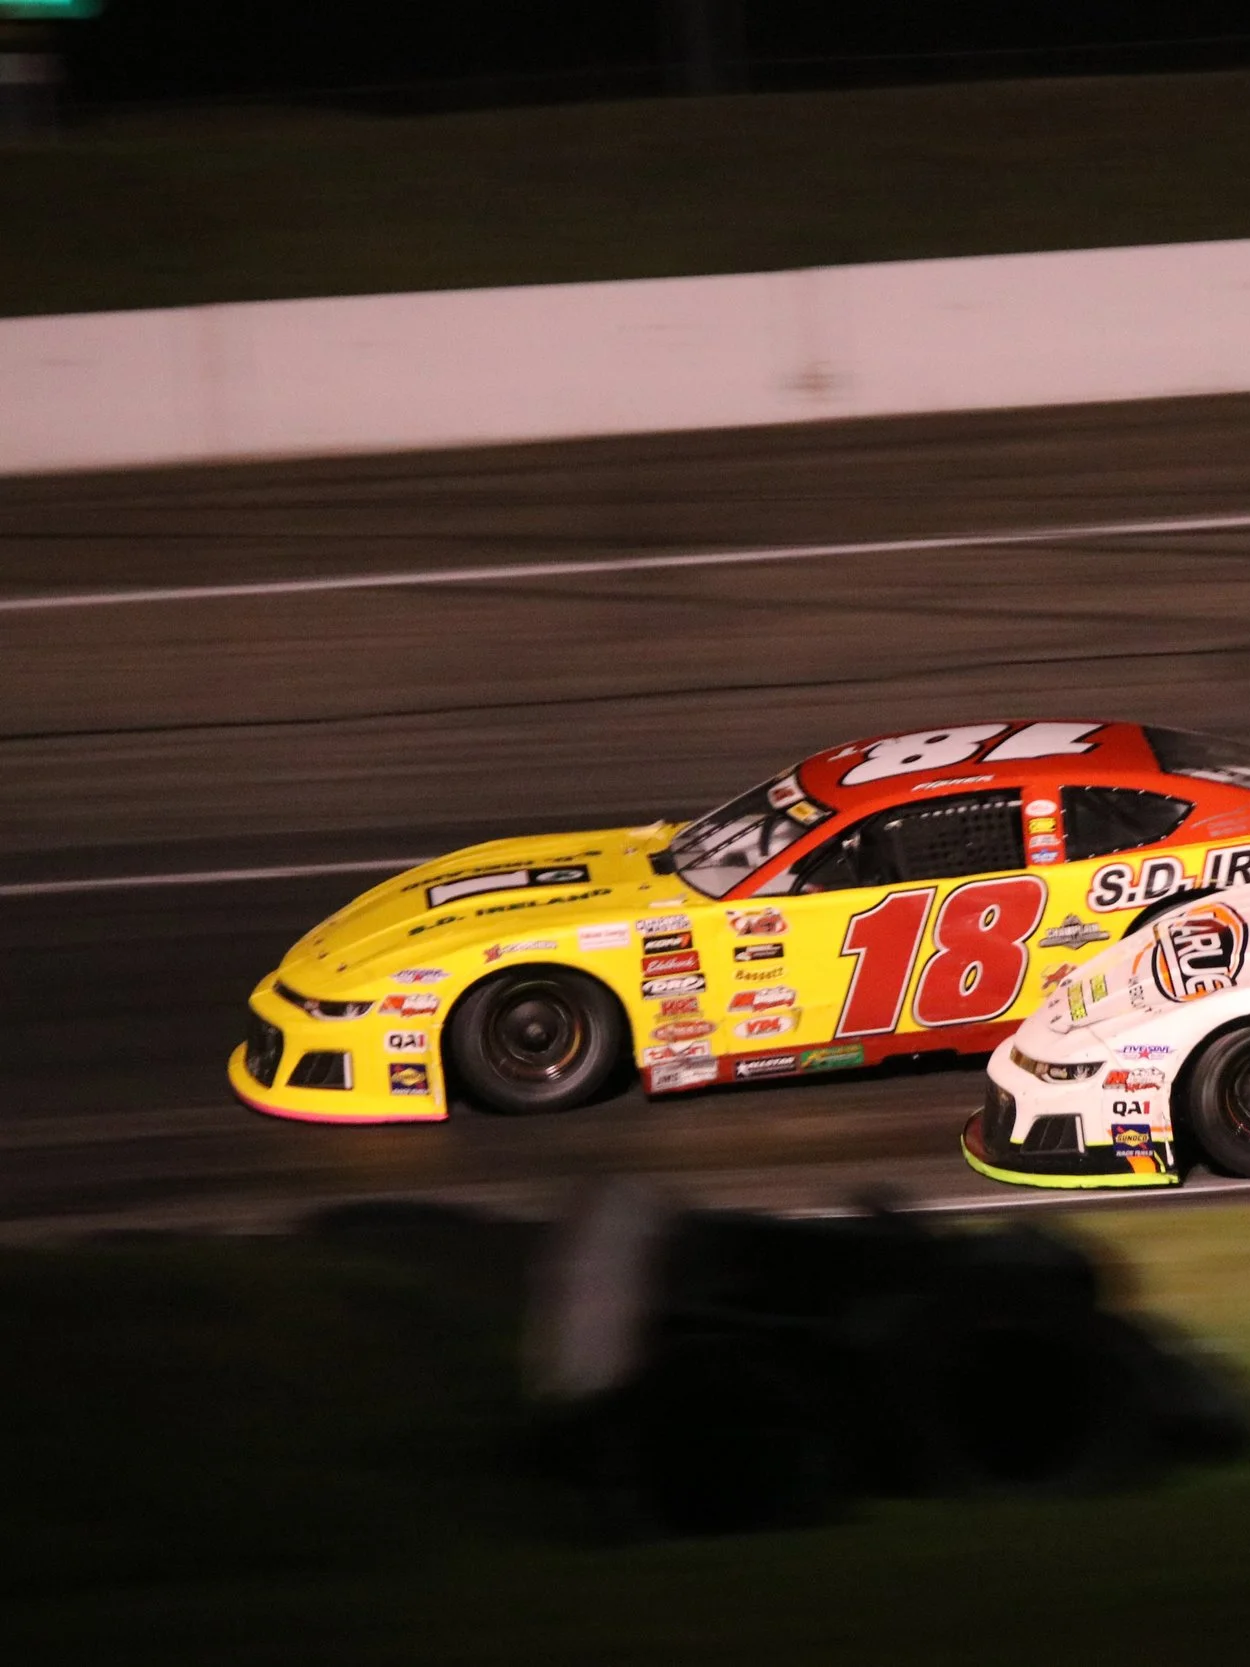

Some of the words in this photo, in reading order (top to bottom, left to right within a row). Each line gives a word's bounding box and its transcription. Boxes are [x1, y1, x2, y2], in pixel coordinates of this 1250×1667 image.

[1094, 859, 1189, 907] S.D.
[835, 874, 1048, 1038] 18
[389, 1034, 424, 1050] QA1
[1112, 1100, 1151, 1117] QA1
[1116, 1134, 1148, 1142] SUNOCO
